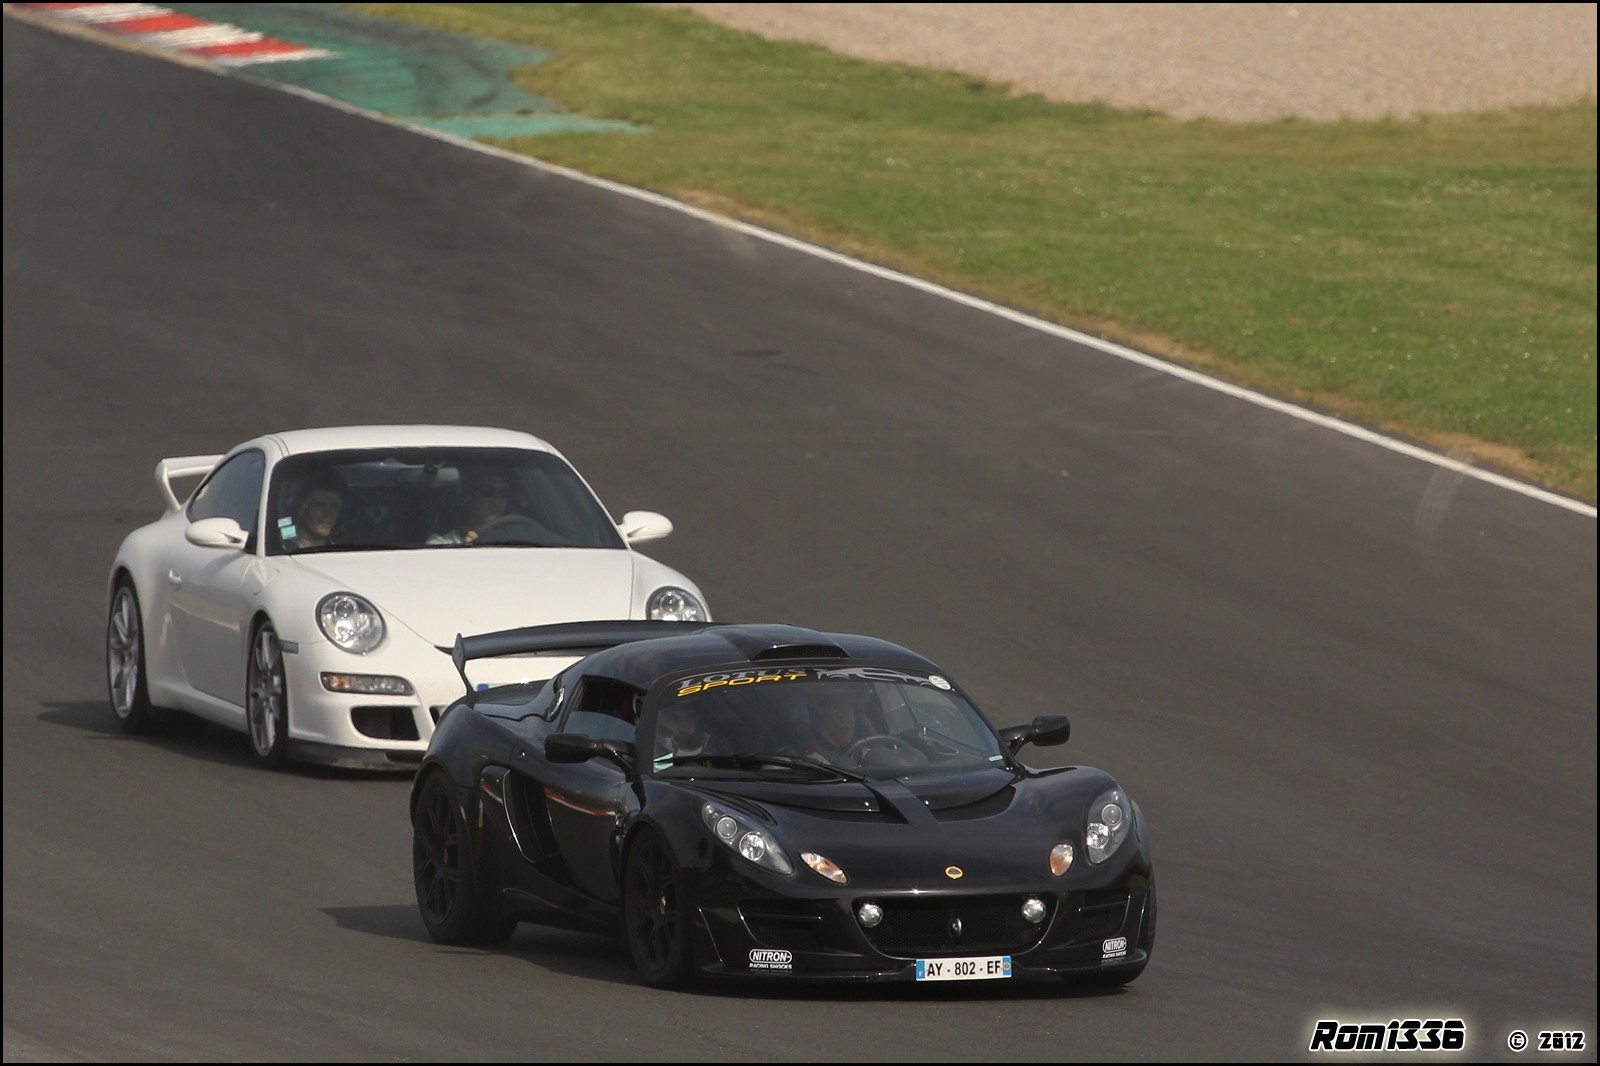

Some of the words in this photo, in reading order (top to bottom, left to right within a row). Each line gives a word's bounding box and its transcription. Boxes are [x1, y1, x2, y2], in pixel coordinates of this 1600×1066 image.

[677, 668, 806, 691] LOTUS
[677, 673, 807, 697] SPORT
[753, 951, 788, 962] NITRON
